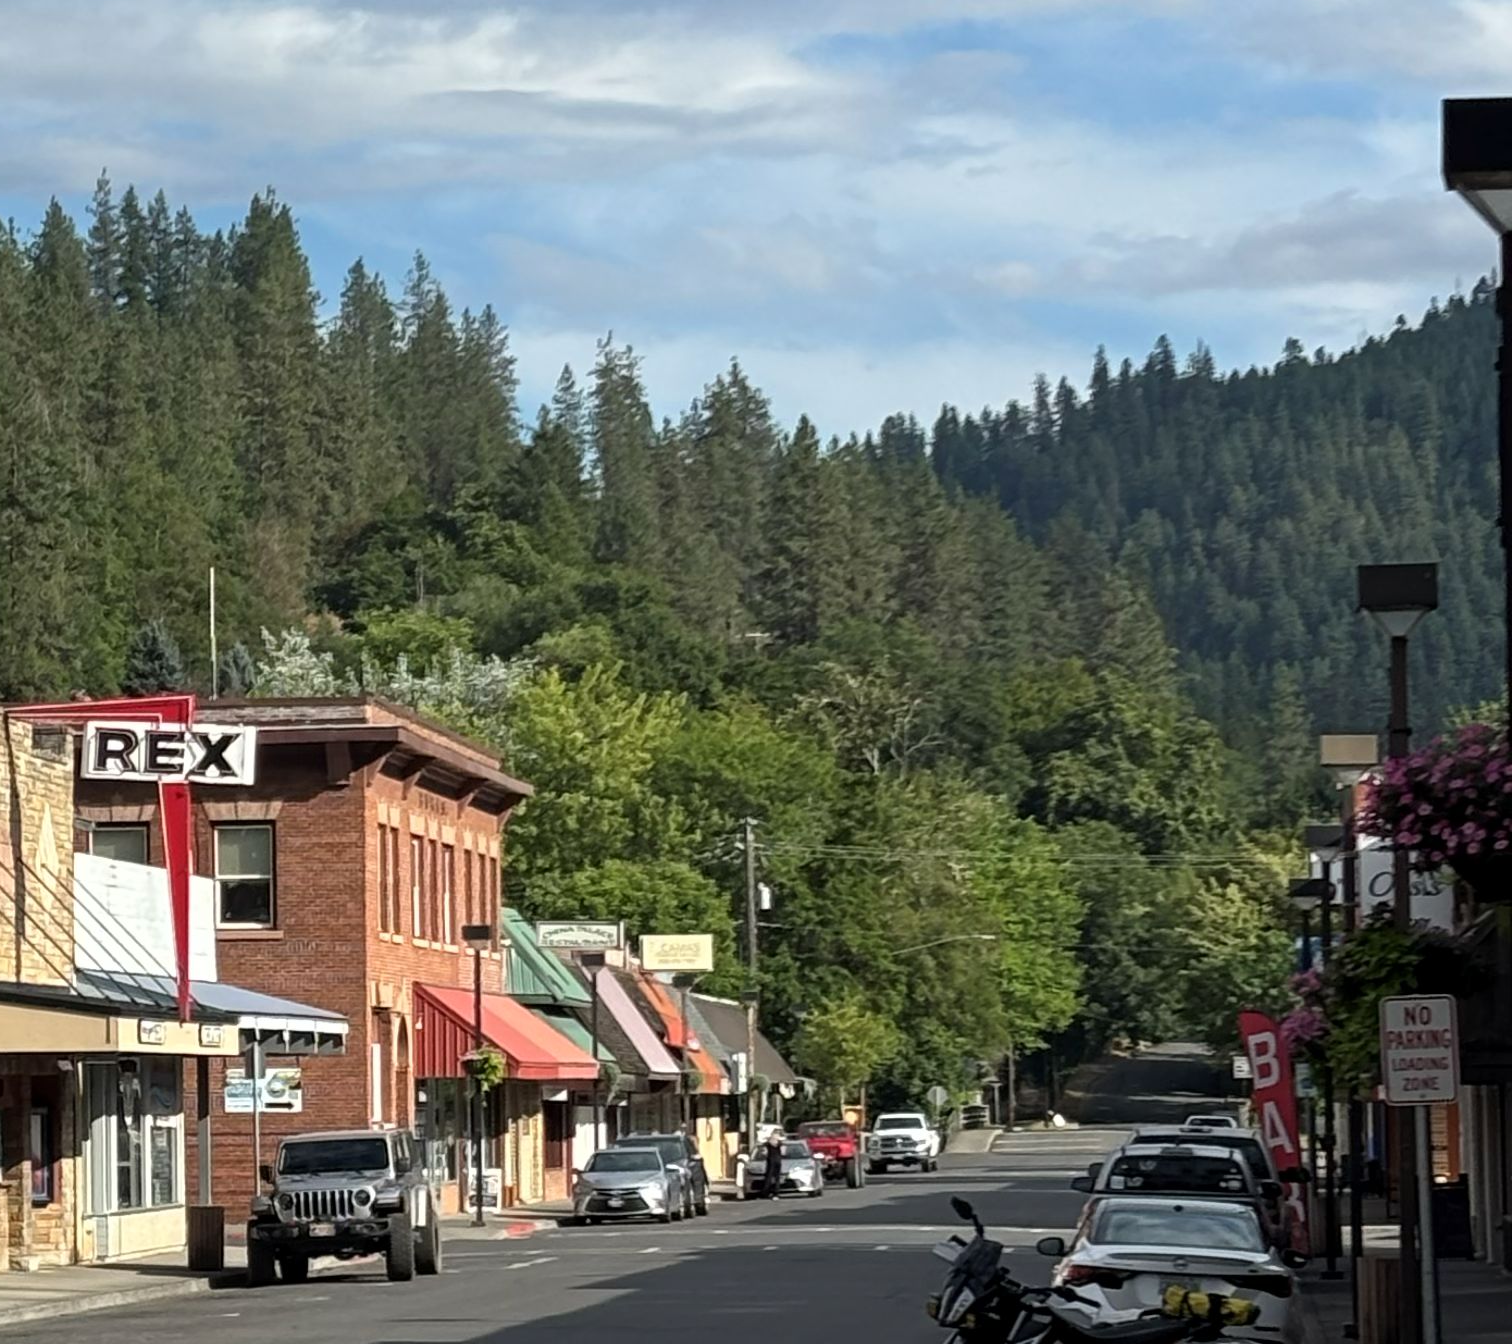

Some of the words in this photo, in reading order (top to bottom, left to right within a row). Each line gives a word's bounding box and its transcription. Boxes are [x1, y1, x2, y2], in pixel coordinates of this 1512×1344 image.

[92, 726, 242, 778] REX
[1369, 870, 1443, 897] Osis
[1403, 1006, 1433, 1026] NO
[1387, 1028, 1451, 1050] PARKING
[1392, 1056, 1450, 1072] LOADING
[1402, 1076, 1440, 1092] ZONE
